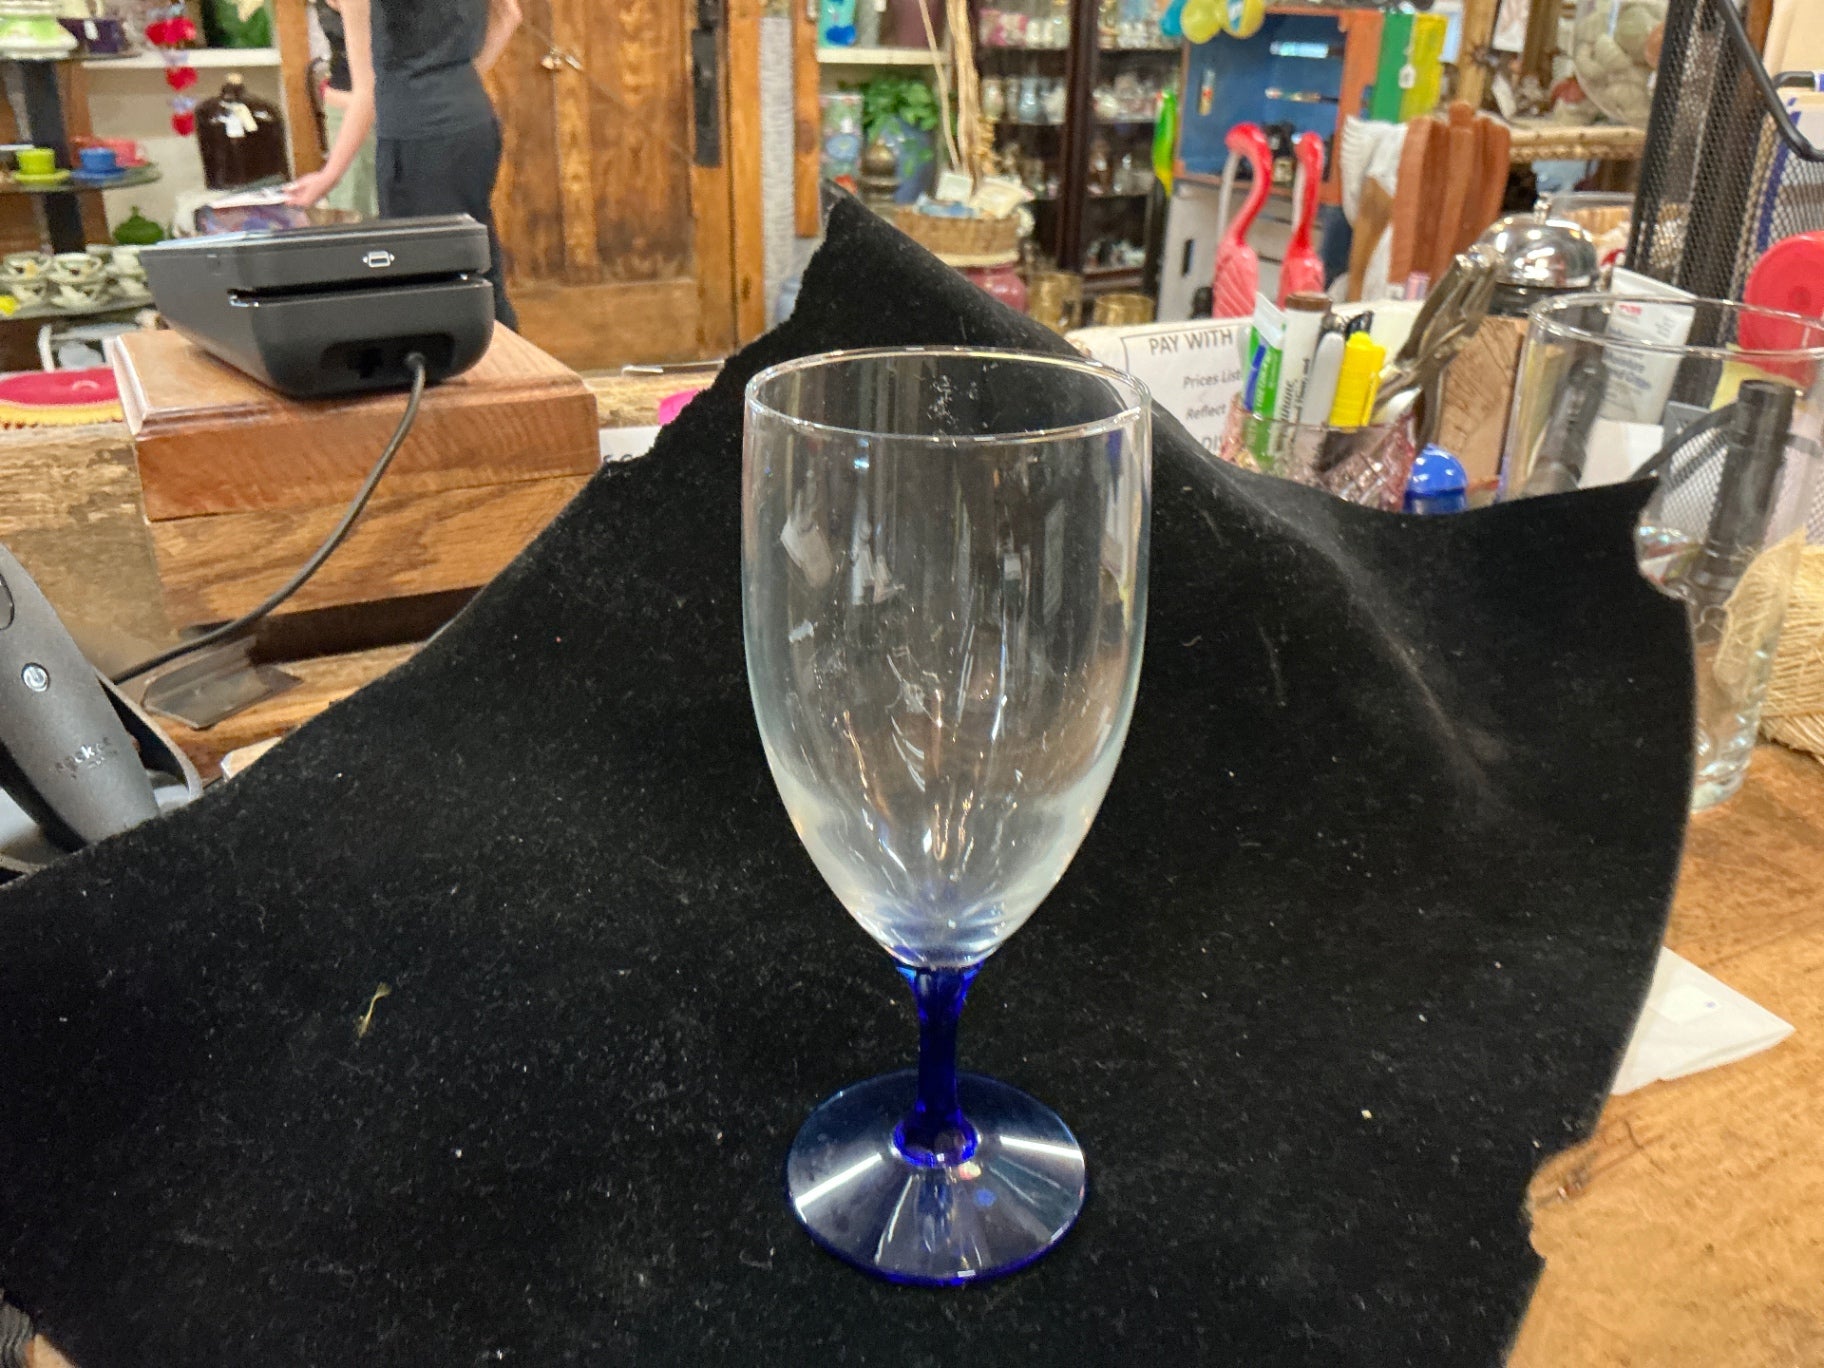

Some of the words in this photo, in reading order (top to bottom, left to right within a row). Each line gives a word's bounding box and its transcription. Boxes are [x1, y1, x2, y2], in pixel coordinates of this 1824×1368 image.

[1148, 333, 1179, 355] PAY
[1183, 328, 1233, 350] WITH
[1183, 373, 1219, 389] Prices
[1186, 403, 1226, 420] Reflect
